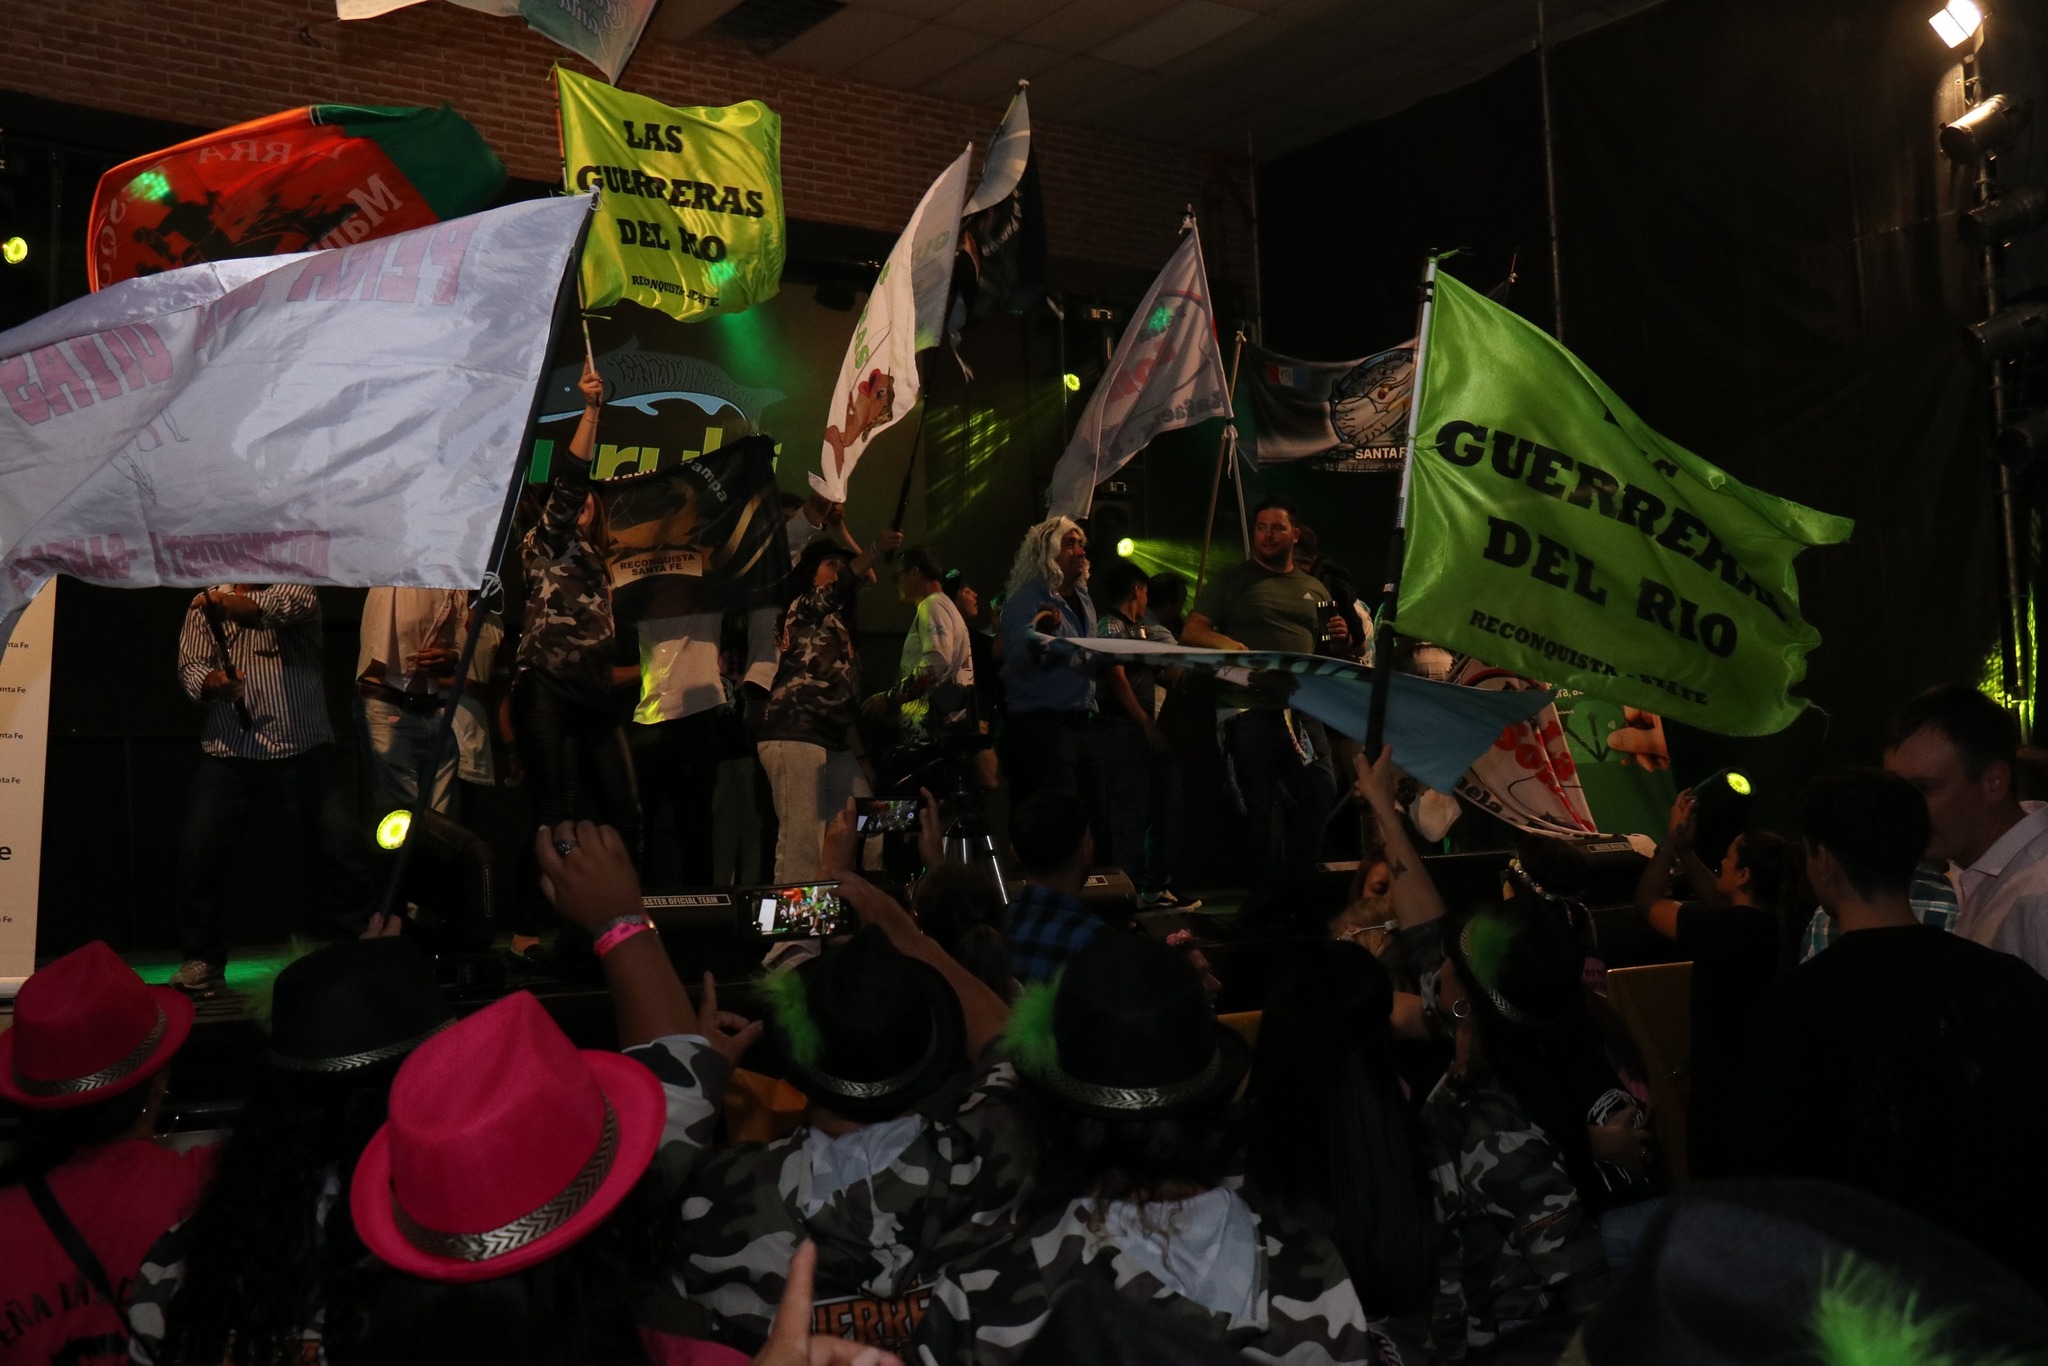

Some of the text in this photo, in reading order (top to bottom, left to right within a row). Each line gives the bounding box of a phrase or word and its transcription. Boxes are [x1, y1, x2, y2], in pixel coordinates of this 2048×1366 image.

[623, 120, 683, 154] LAS
[577, 165, 765, 219] GUERRERAS
[617, 218, 670, 251] DEL
[1354, 447, 1398, 460] SANTA
[619, 553, 696, 570] RECONQUISTA
[631, 562, 683, 576] SANTA FE
[1483, 515, 1738, 658] DEL RIO
[17, 686, 26, 694] Fe
[11, 776, 21, 784] Fe
[669, 897, 697, 906] OFICIAL
[696, 896, 719, 904] TEAM
